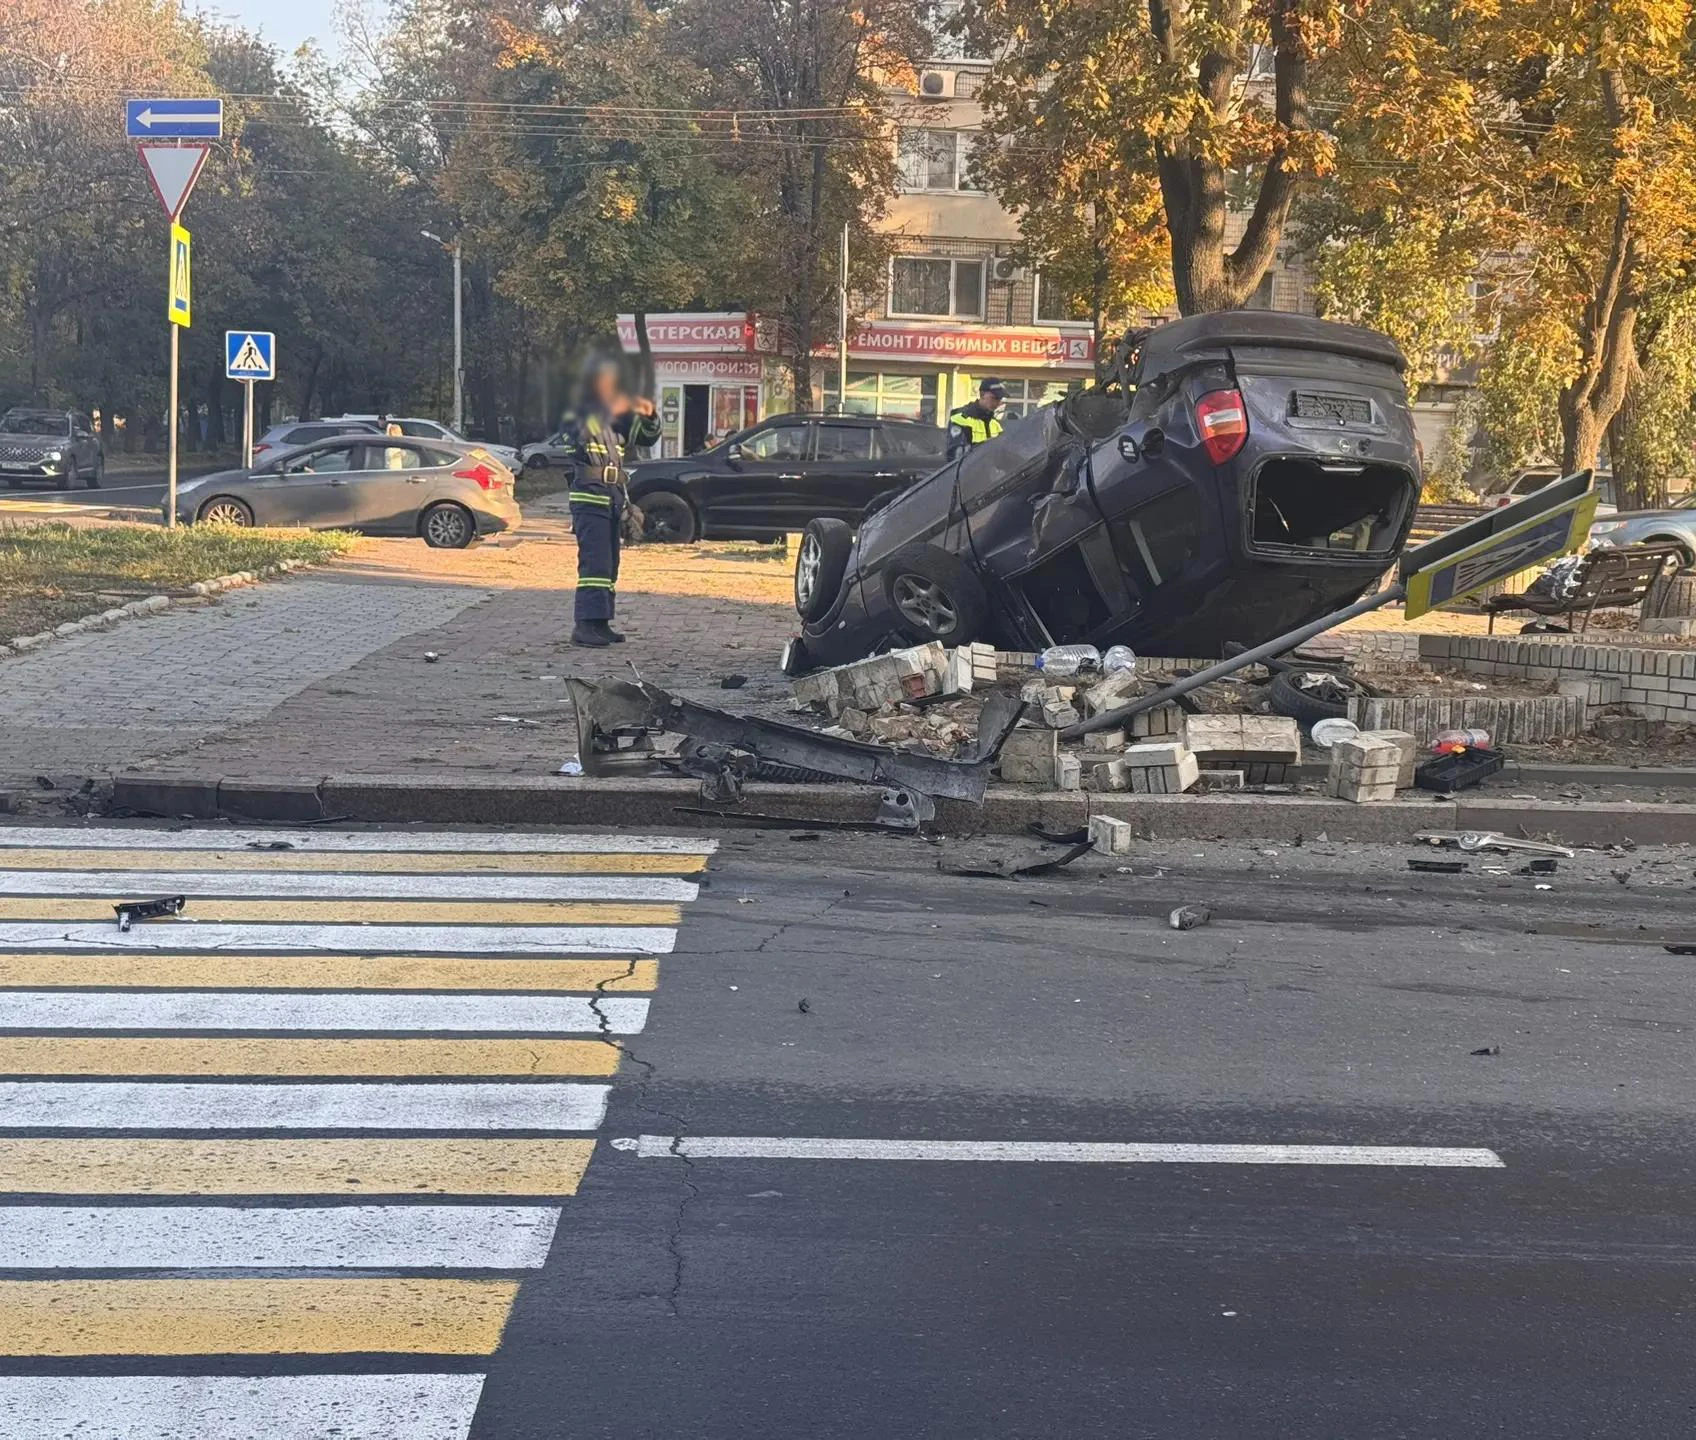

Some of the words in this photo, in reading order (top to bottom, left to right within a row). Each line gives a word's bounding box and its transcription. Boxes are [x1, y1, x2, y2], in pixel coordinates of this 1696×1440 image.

[617, 325, 741, 341] МСТЕРСКАЯ
[916, 335, 1007, 353] ЛЮБИМЫХ
[654, 360, 688, 374] КОГО
